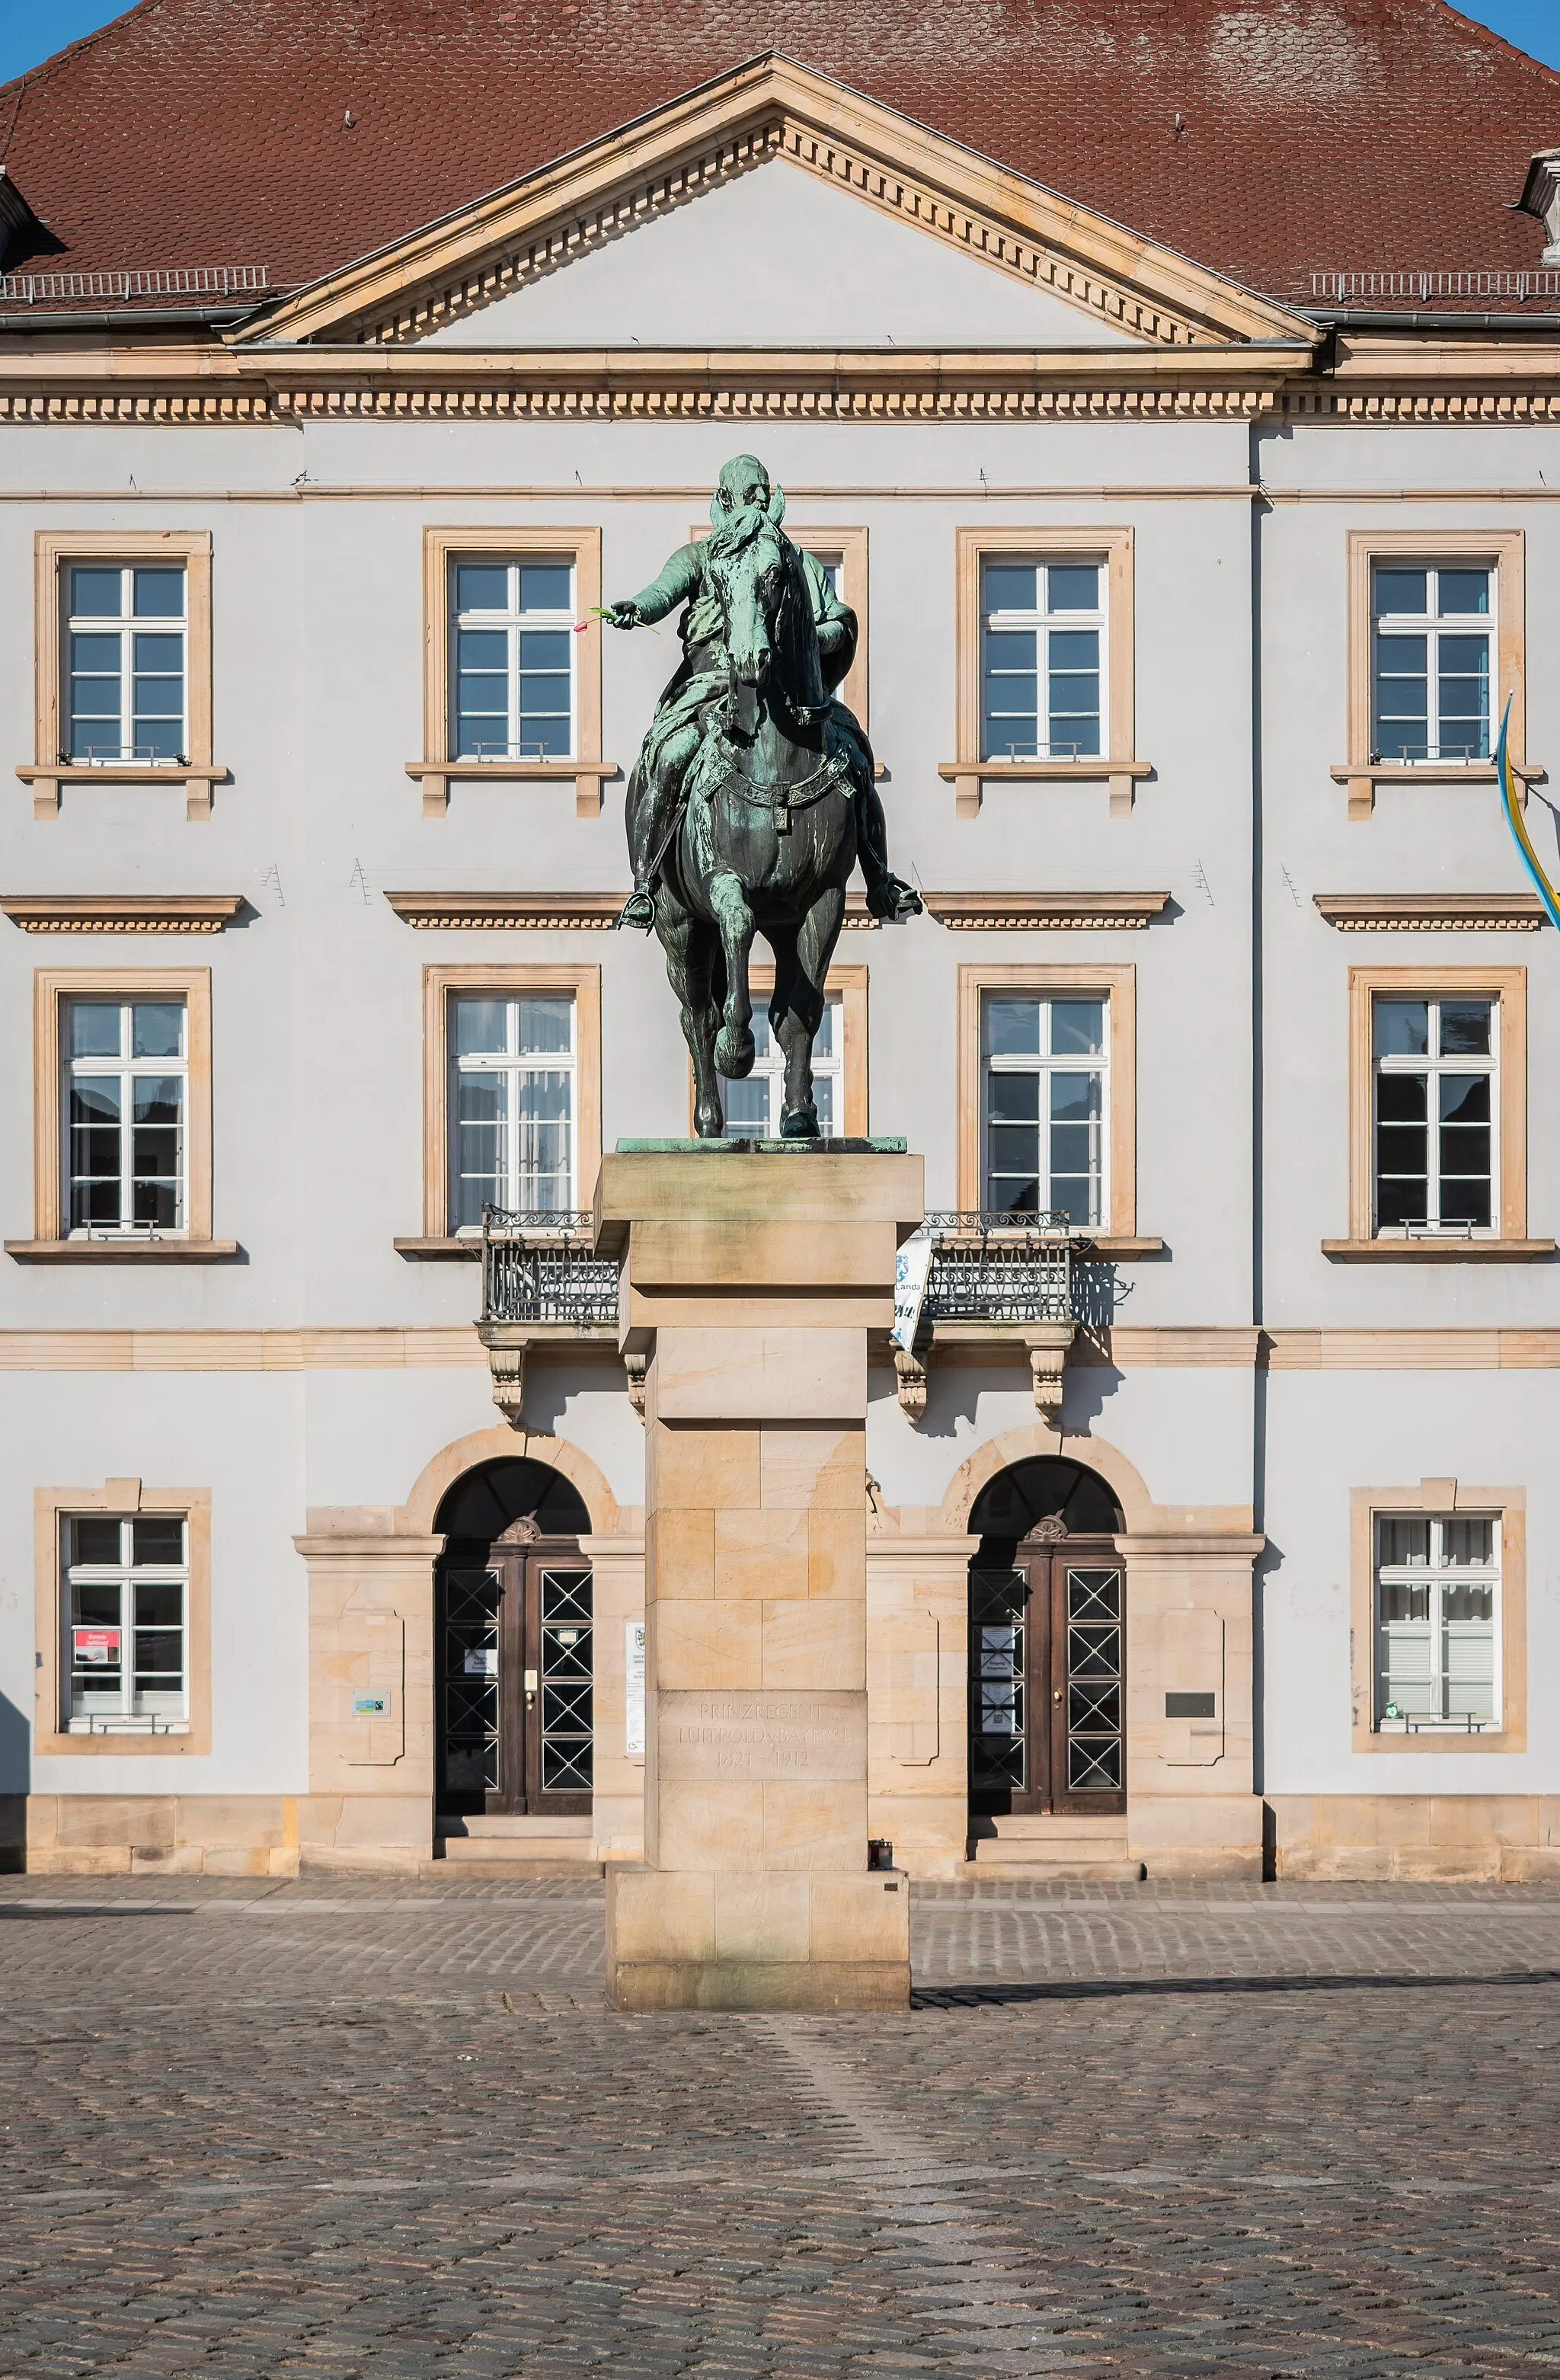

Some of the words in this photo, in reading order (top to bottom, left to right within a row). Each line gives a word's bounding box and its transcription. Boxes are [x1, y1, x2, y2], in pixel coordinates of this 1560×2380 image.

[700, 1703, 823, 1719] PRINZREGENT
[679, 1727, 766, 1744] LUITPOLD
[778, 1727, 847, 1743] BAYERN
[716, 1751, 752, 1767] 1821
[774, 1751, 809, 1767] 1912
